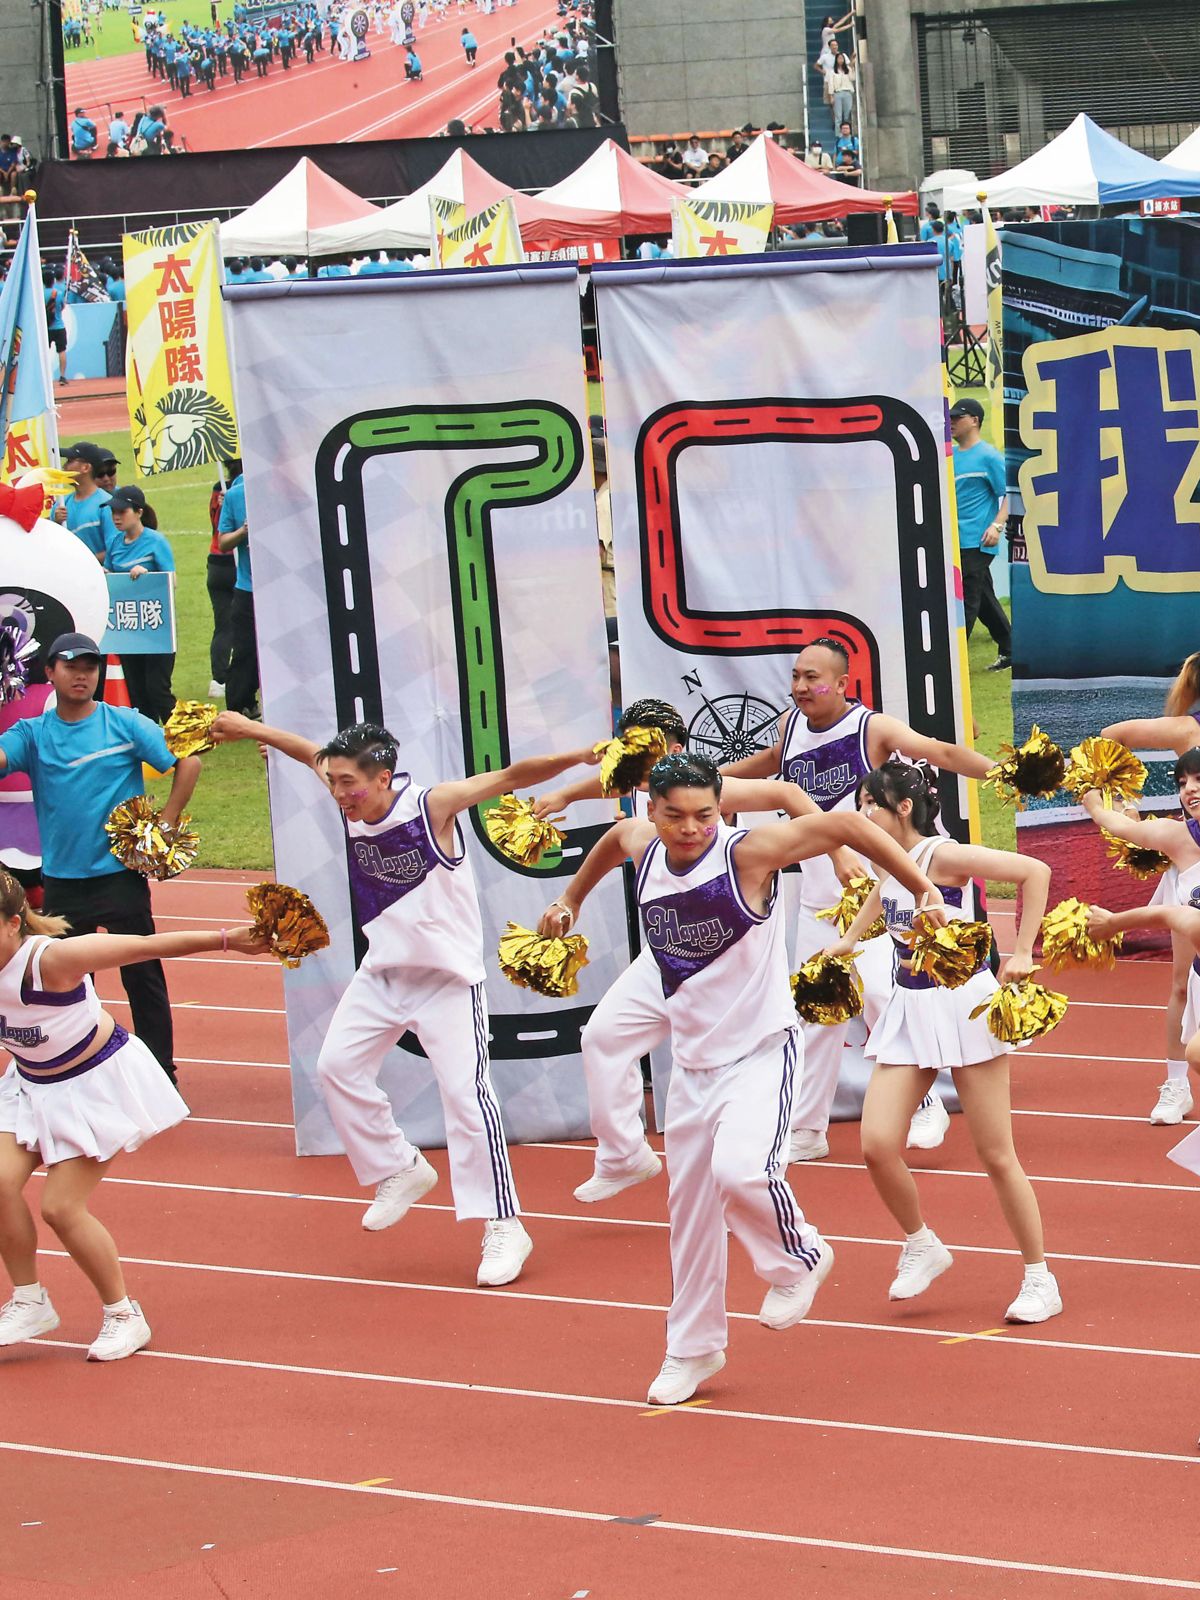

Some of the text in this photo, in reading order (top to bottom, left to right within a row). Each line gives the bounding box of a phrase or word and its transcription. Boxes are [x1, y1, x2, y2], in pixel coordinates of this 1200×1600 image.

[153, 254, 203, 386] 太陽隊
[681, 668, 703, 695] N
[789, 760, 857, 796] Happy
[354, 841, 427, 880] Happy
[646, 905, 734, 952] Happy
[881, 896, 914, 930] Hap
